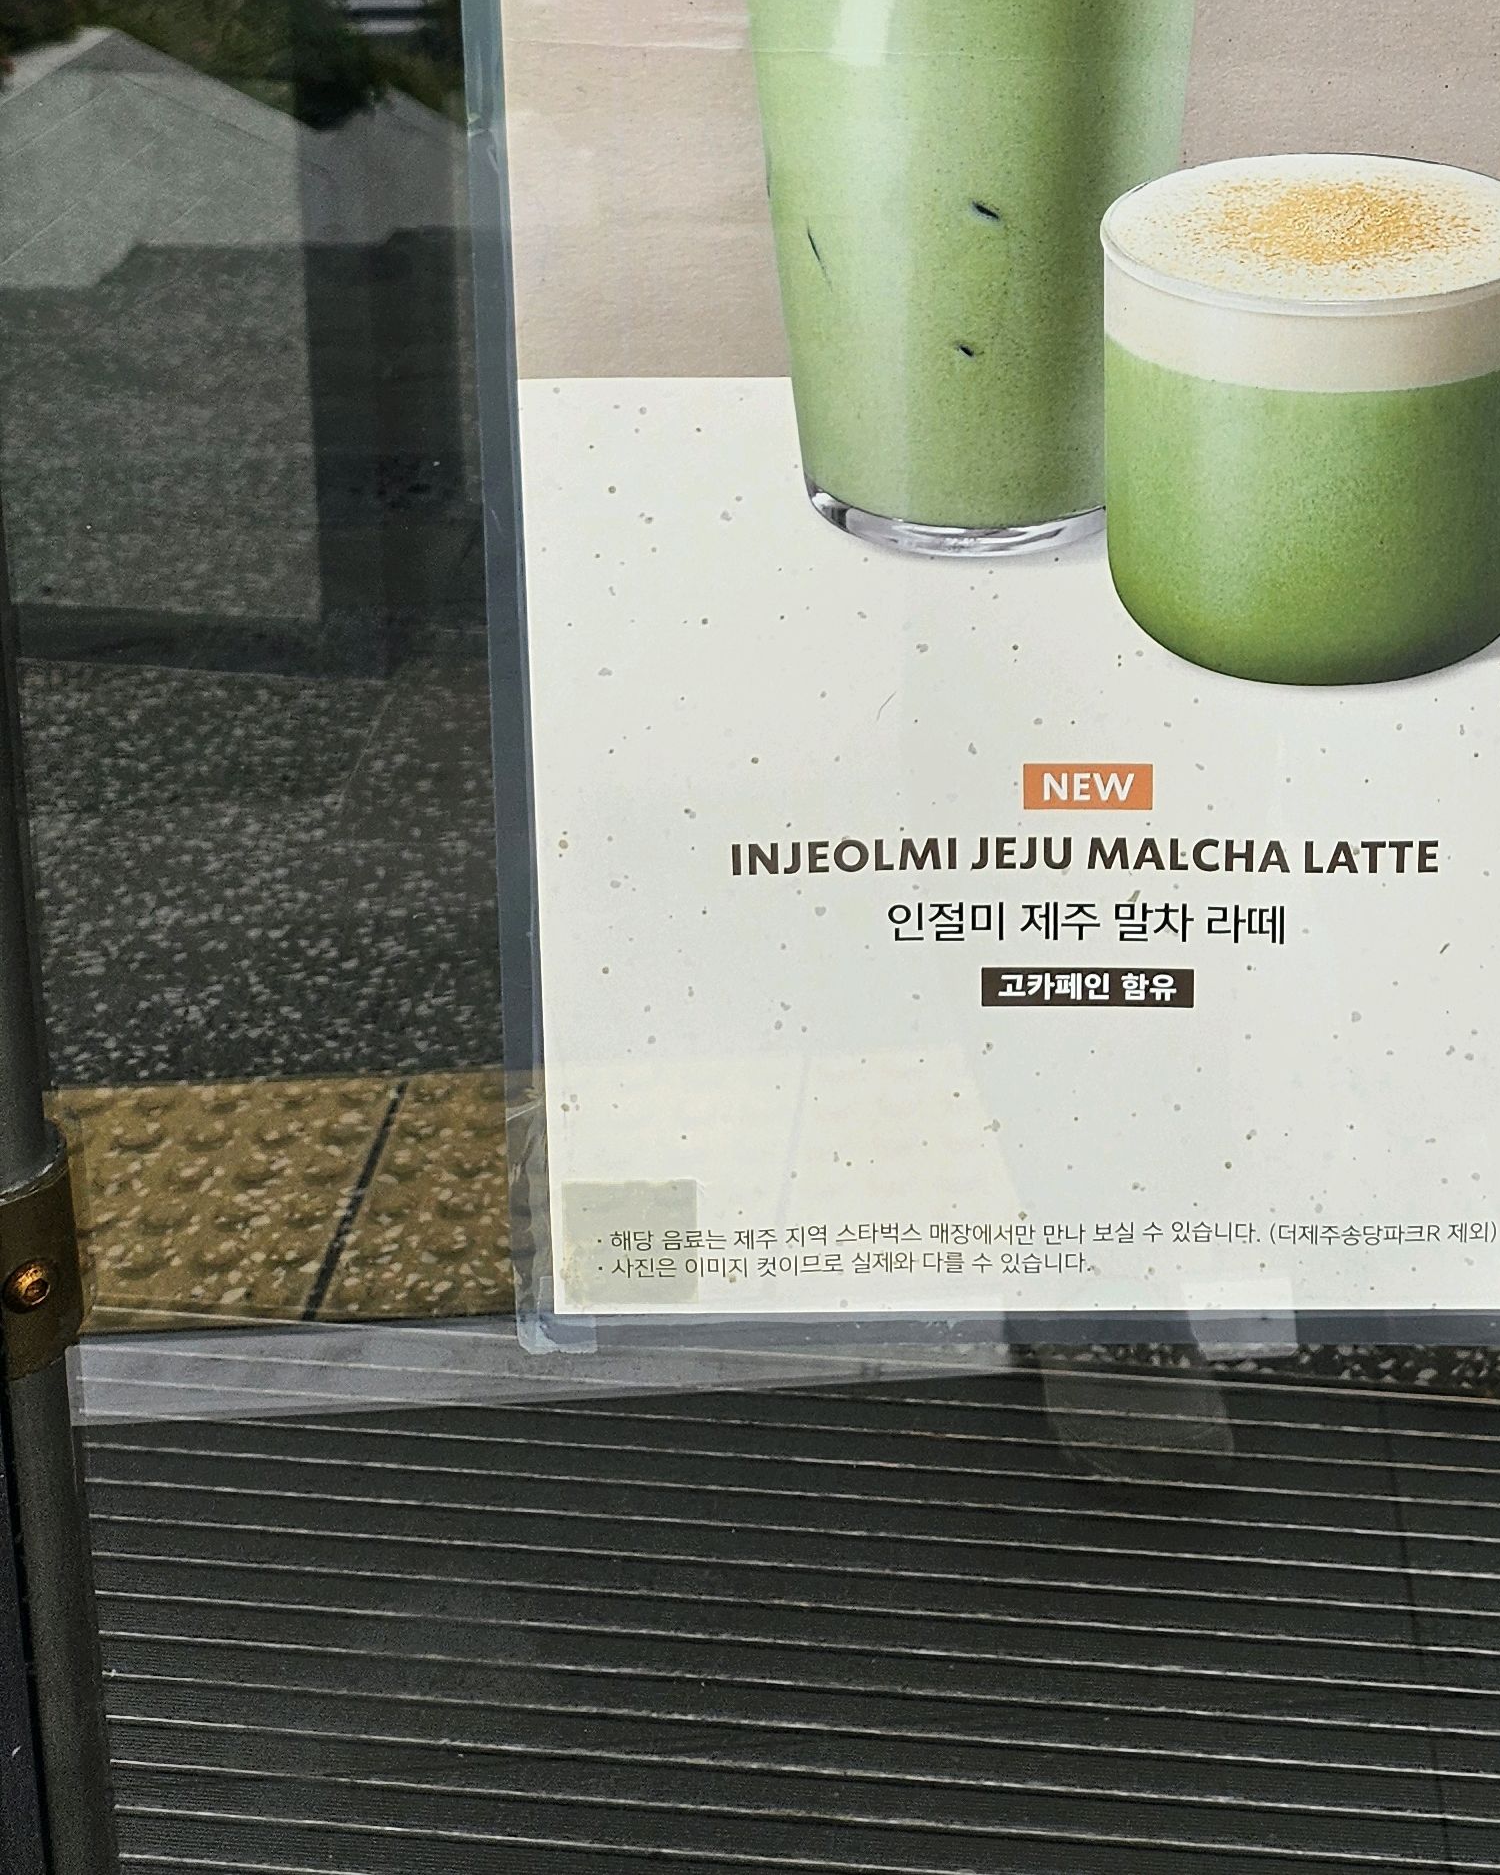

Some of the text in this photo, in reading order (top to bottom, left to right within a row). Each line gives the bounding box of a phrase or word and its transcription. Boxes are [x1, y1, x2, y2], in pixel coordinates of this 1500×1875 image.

[1043, 772, 1135, 802] NEW
[731, 836, 1439, 876] INJEOLMI JEJU MALCHA LATTE
[887, 902, 1286, 945] 인절미 제주 말차 라떼
[998, 972, 1177, 1002] 고카페인 함유
[609, 1220, 1497, 1252] 해당 음료는 제주 지역 스타벅스 매장에서만 만나 보실 수 있습니다. (더제주송당파크R 제외)
[611, 1251, 1092, 1279] 사진은 이미지 컷이므로 실제와 다를 수 있습니다.
